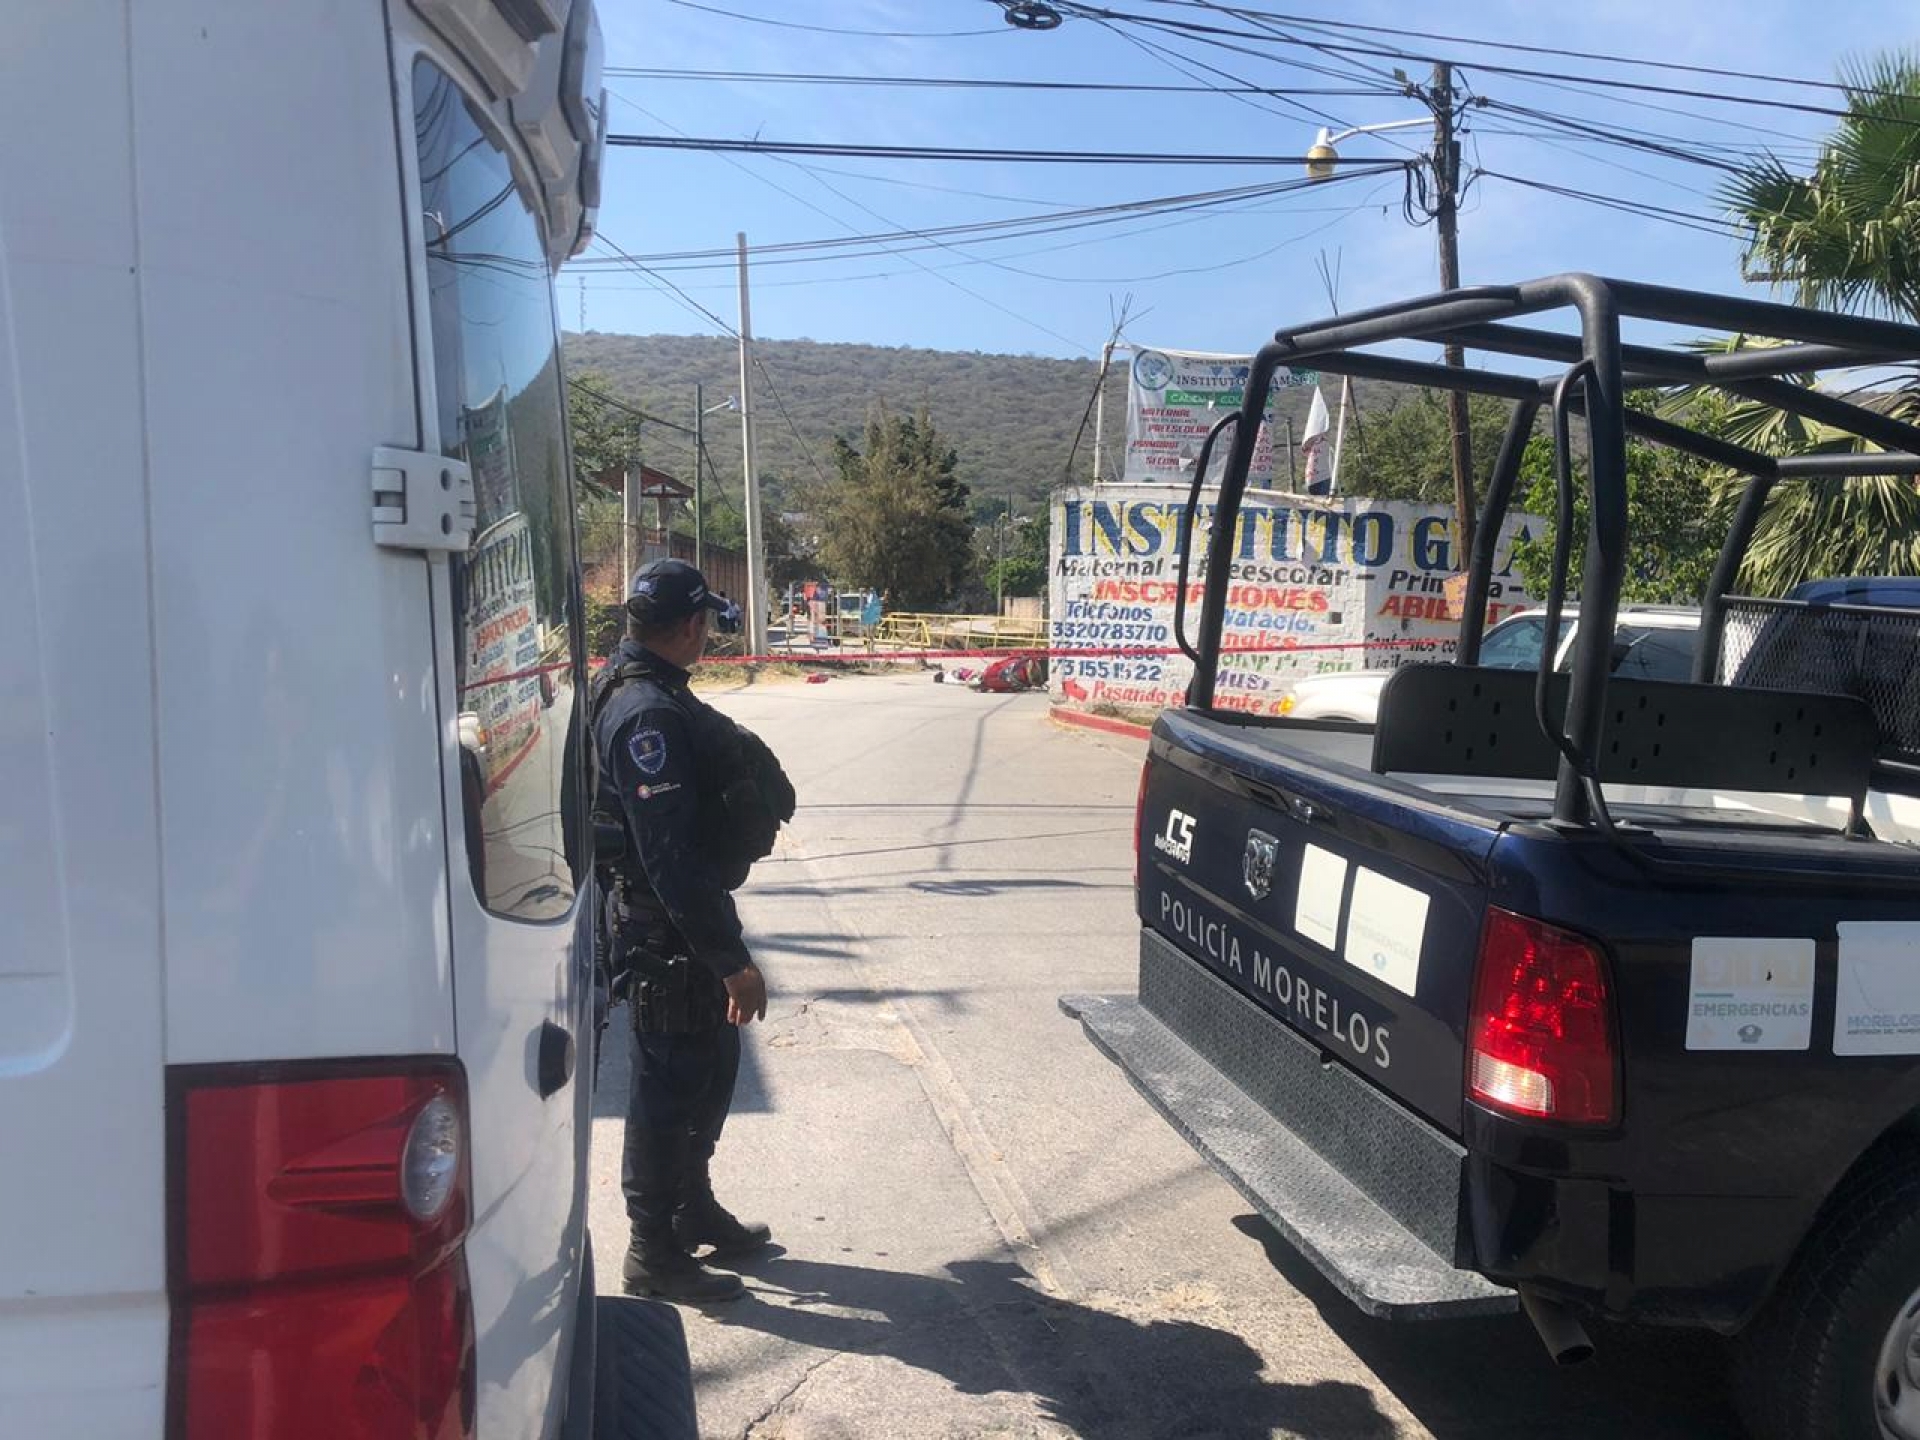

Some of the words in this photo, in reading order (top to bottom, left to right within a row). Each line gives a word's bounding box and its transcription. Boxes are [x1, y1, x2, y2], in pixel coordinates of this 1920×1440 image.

[1176, 374, 1246, 387] INSTITUTO
[1063, 500, 1394, 567] INSTTUTO
[1056, 557, 1165, 577] Maternal
[1160, 890, 1243, 976] POLICÍA
[1252, 950, 1392, 1070] MORELOS
[1692, 1002, 1809, 1018] EMERGENCIAS
